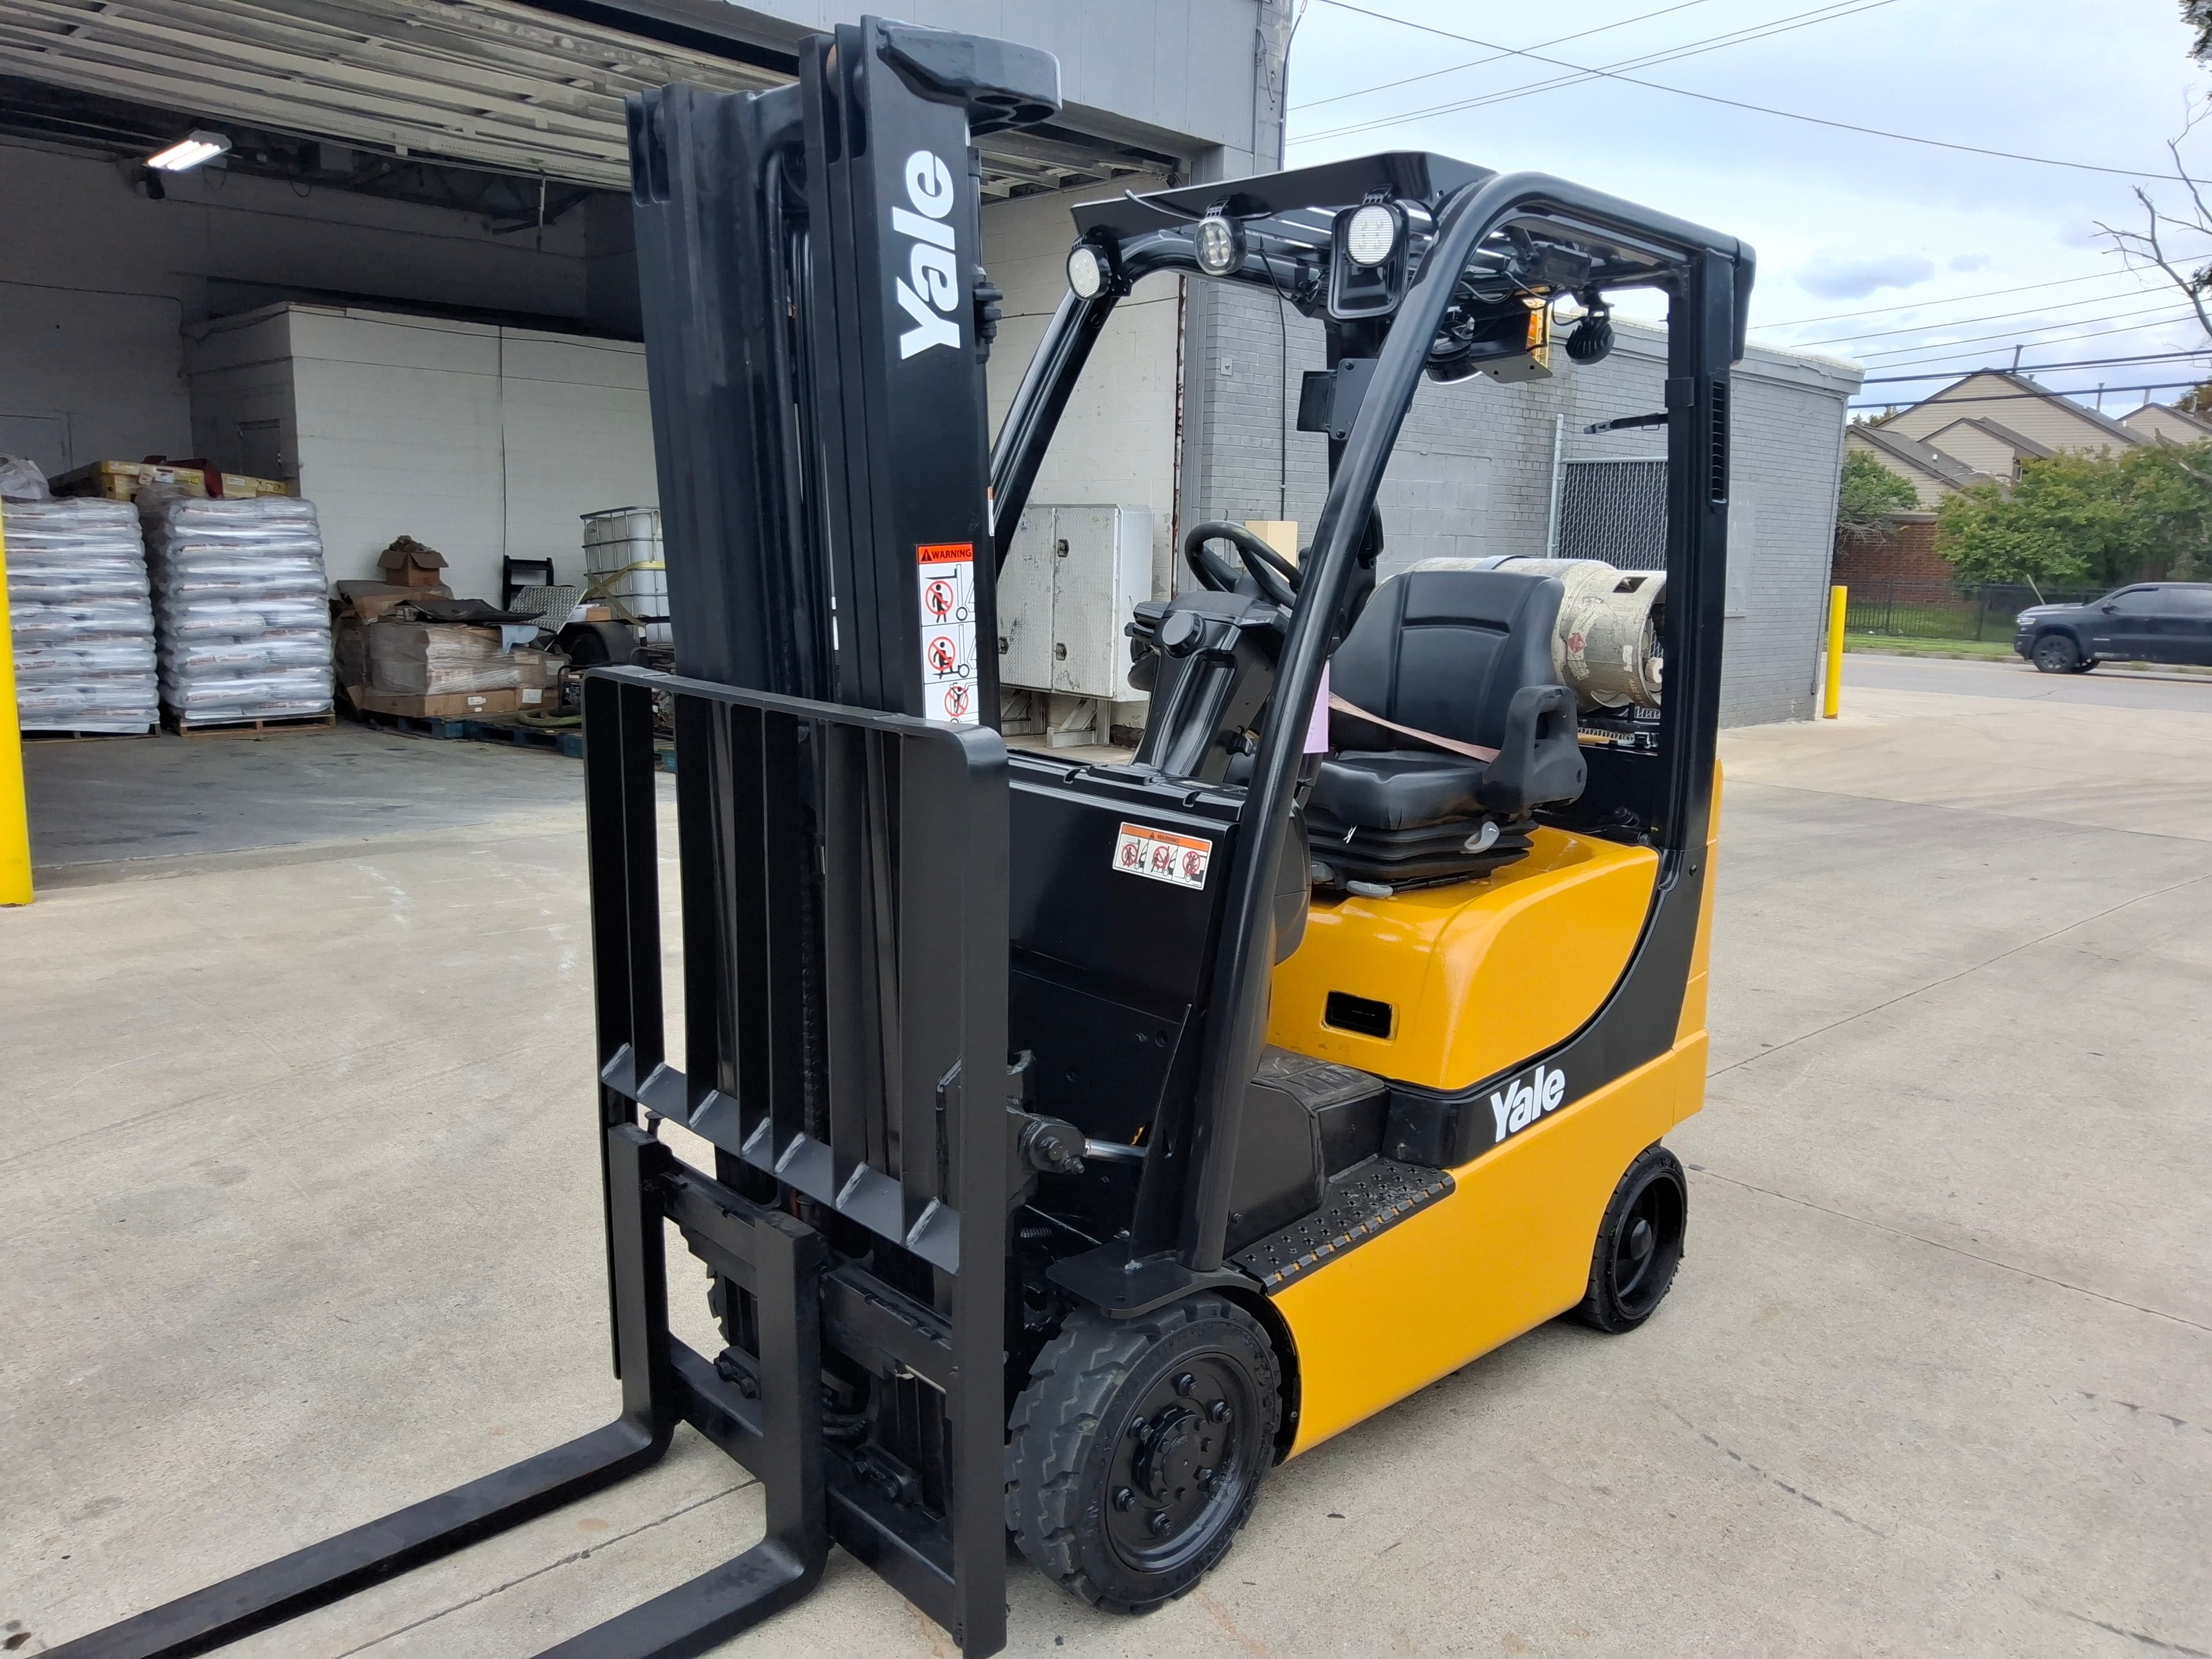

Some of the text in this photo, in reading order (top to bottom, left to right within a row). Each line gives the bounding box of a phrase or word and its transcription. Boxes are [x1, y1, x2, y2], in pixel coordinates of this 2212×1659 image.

[892, 150, 960, 359] Yale
[931, 548, 972, 559] WARNING
[1157, 834, 1180, 844] WARNING
[1490, 1065, 1566, 1143] Yale
